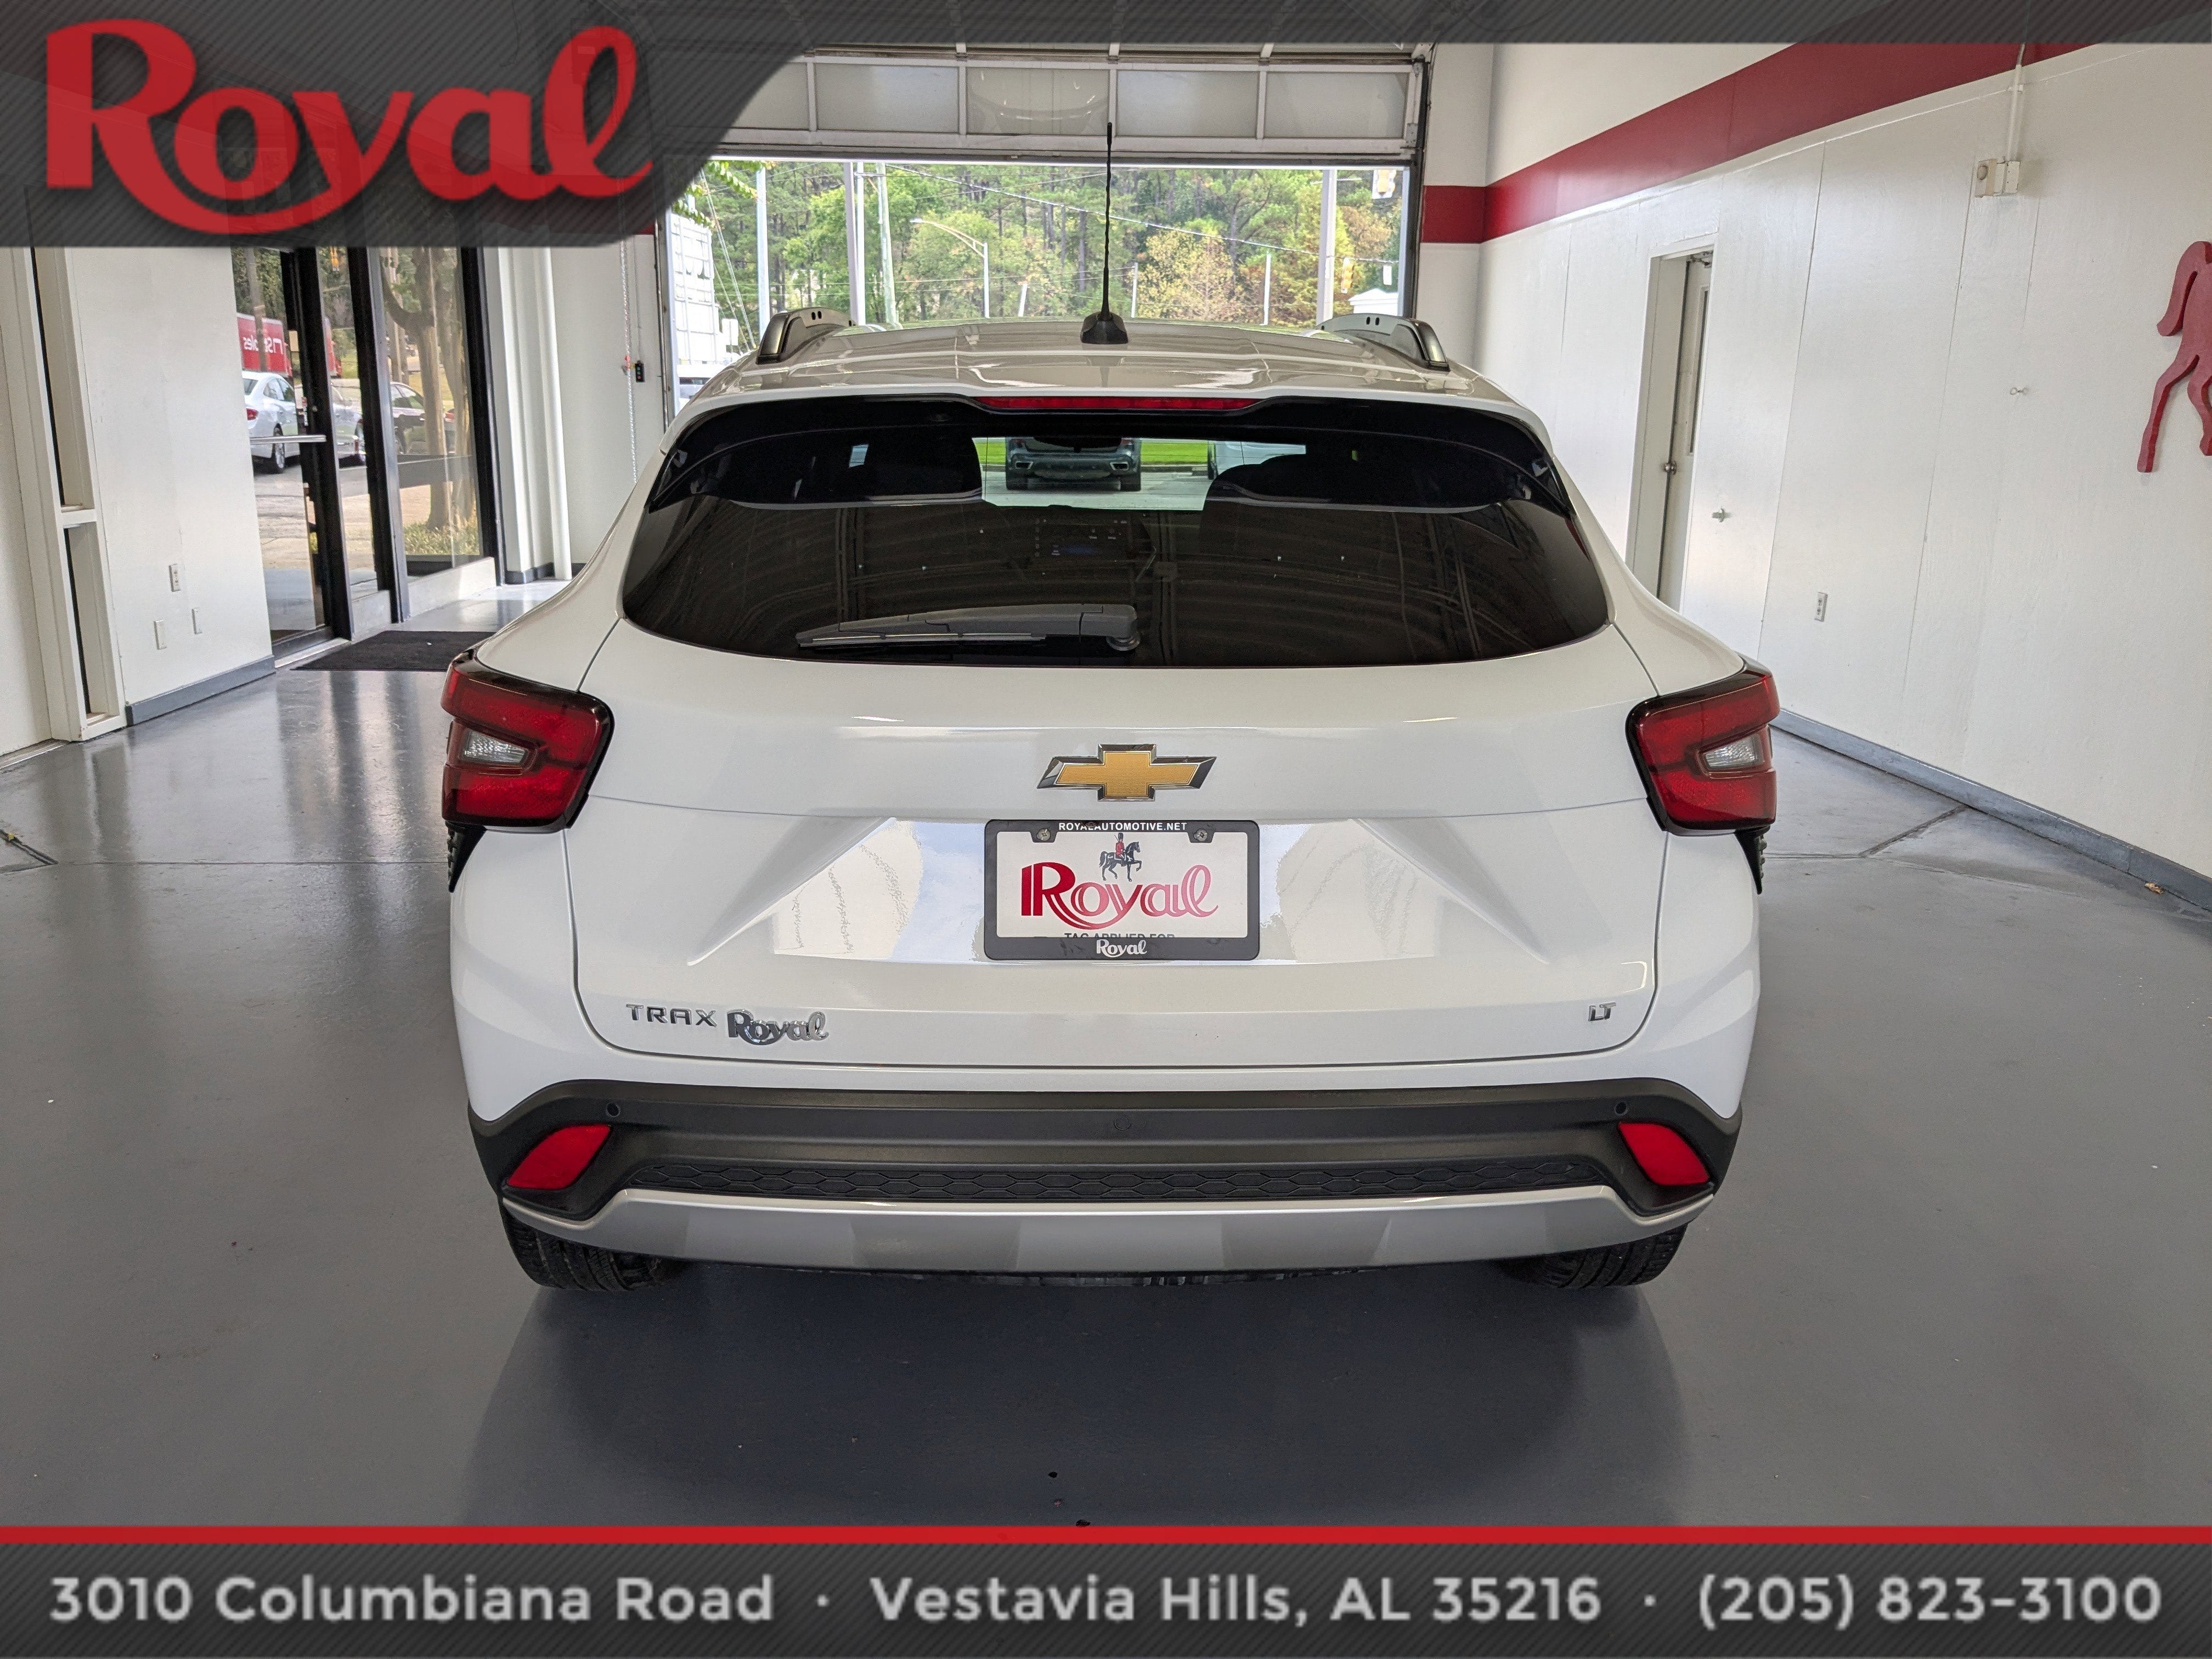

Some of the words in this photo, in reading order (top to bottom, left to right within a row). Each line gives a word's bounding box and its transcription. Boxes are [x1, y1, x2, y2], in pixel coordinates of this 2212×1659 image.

[1021, 862, 1219, 930] Royal
[1096, 939, 1147, 958] Royal
[625, 1003, 718, 1027] TRAX
[727, 1008, 829, 1046] Royal
[1588, 1001, 1617, 1022] LT
